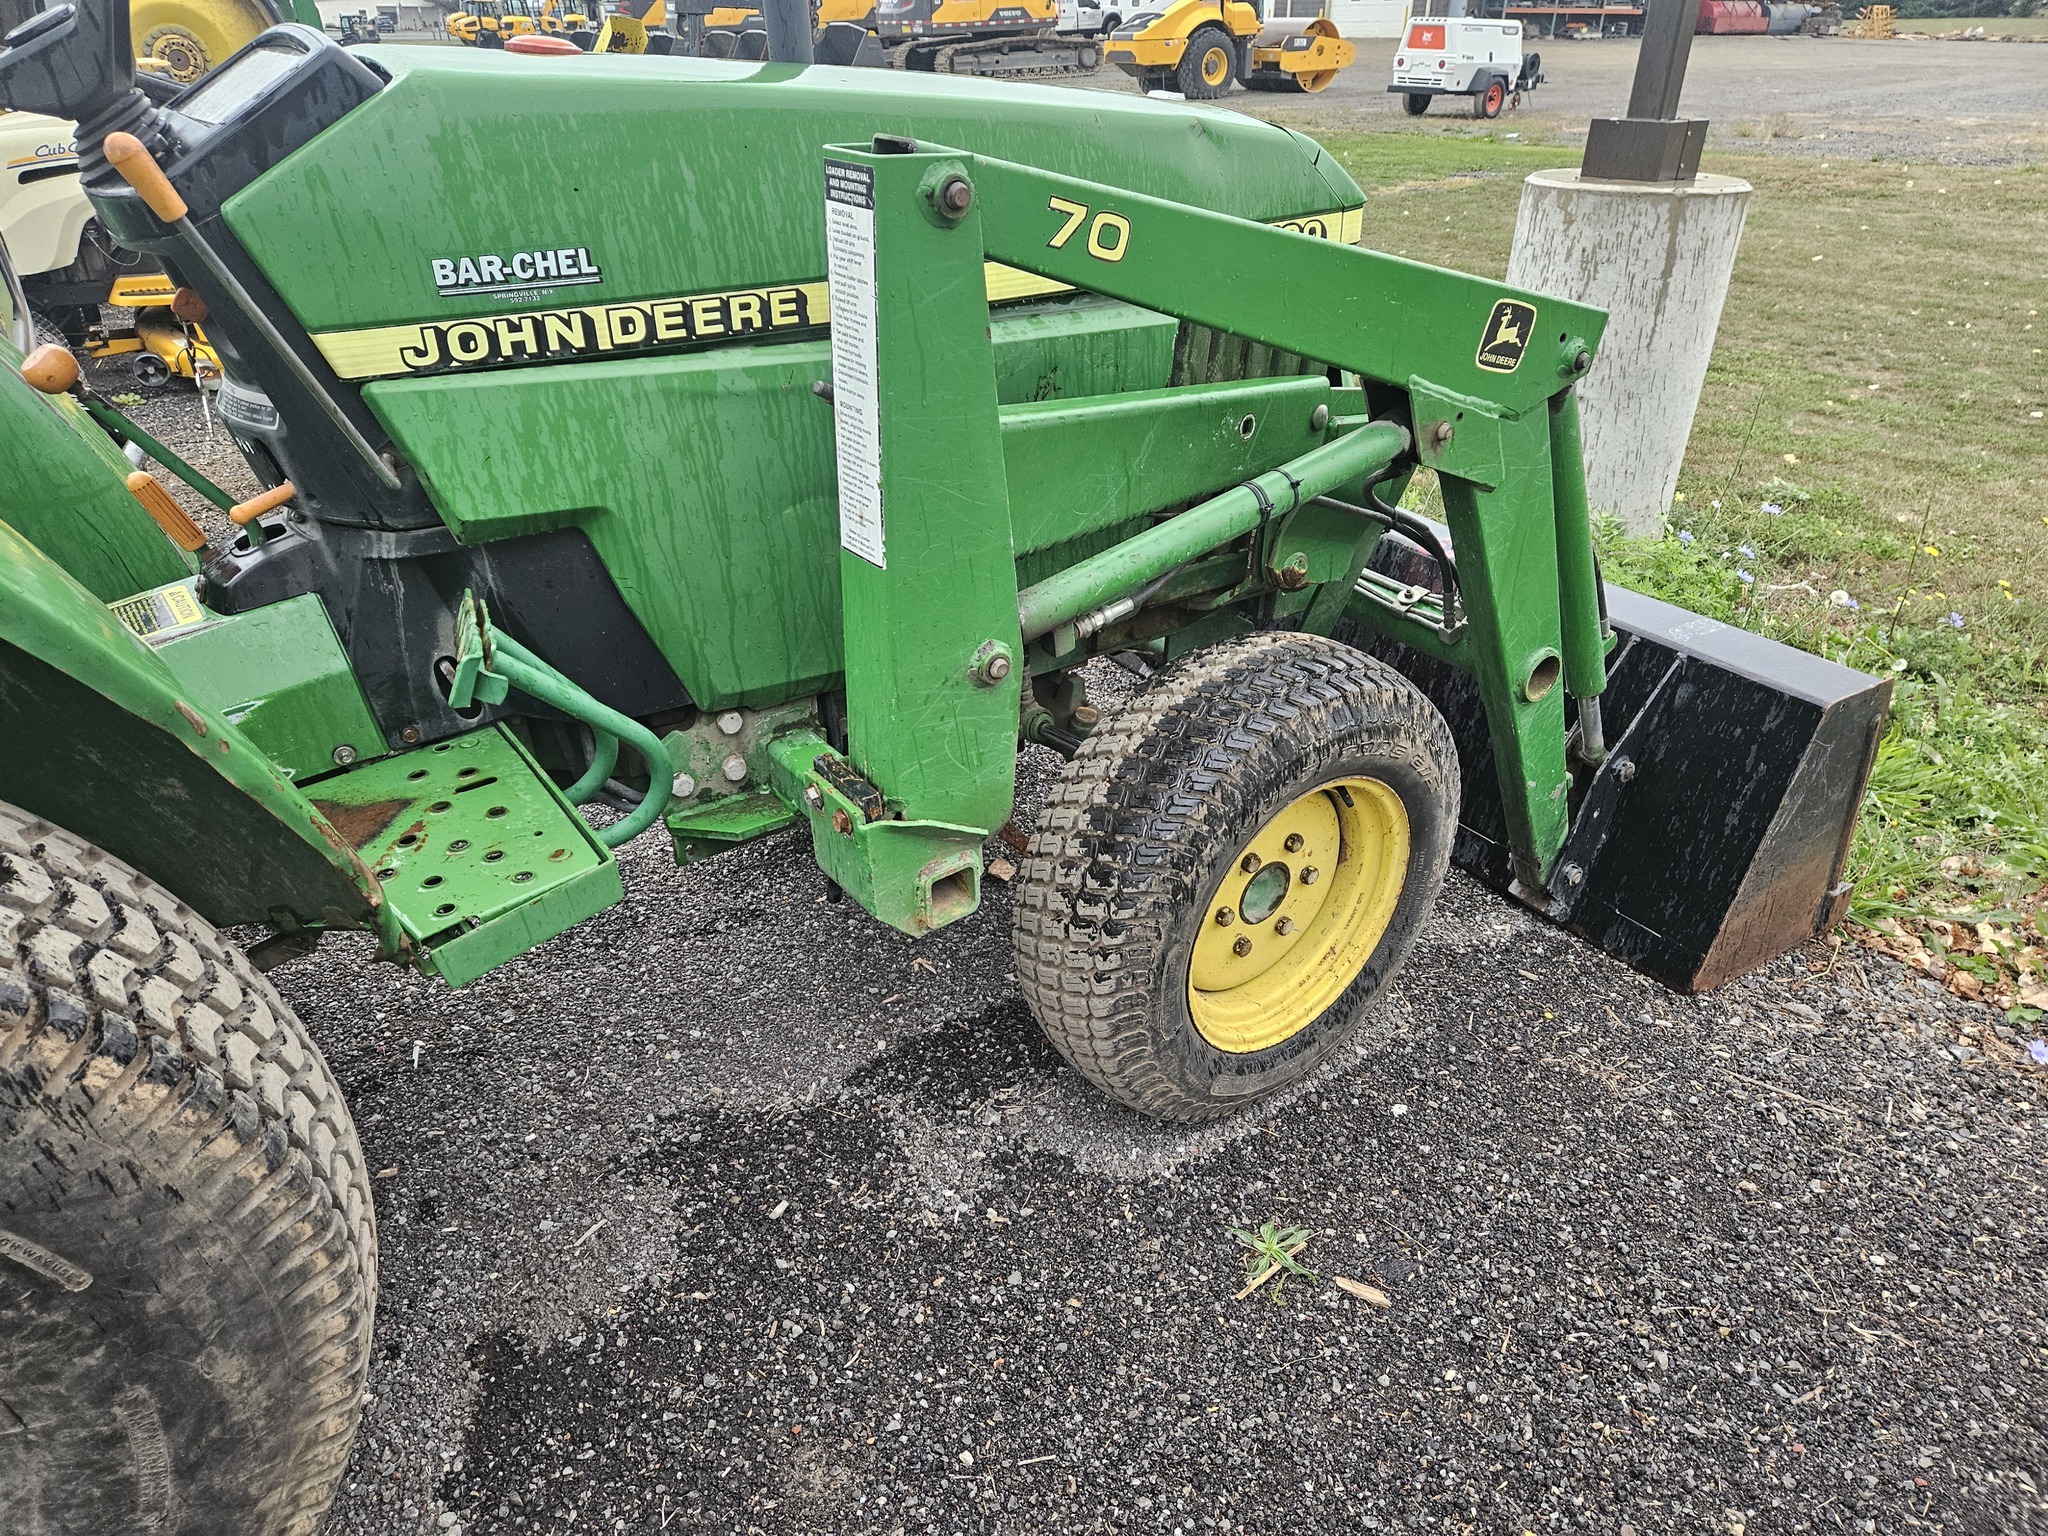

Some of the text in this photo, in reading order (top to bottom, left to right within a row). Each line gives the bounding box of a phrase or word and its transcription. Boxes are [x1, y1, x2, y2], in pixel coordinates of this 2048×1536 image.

[998, 9, 1022, 18] VOLVO
[35, 143, 66, 157] Cub
[826, 165, 870, 183] LOADER REMOVAL
[829, 178, 866, 194] AND MOUNTING
[830, 189, 866, 205] INSTRUCTIONS
[1046, 194, 1132, 263] 70
[431, 247, 603, 288] BAR-CHEL
[401, 313, 588, 368] JOHN
[608, 288, 804, 346] DEERE
[1480, 352, 1516, 366] JOHN DEERE
